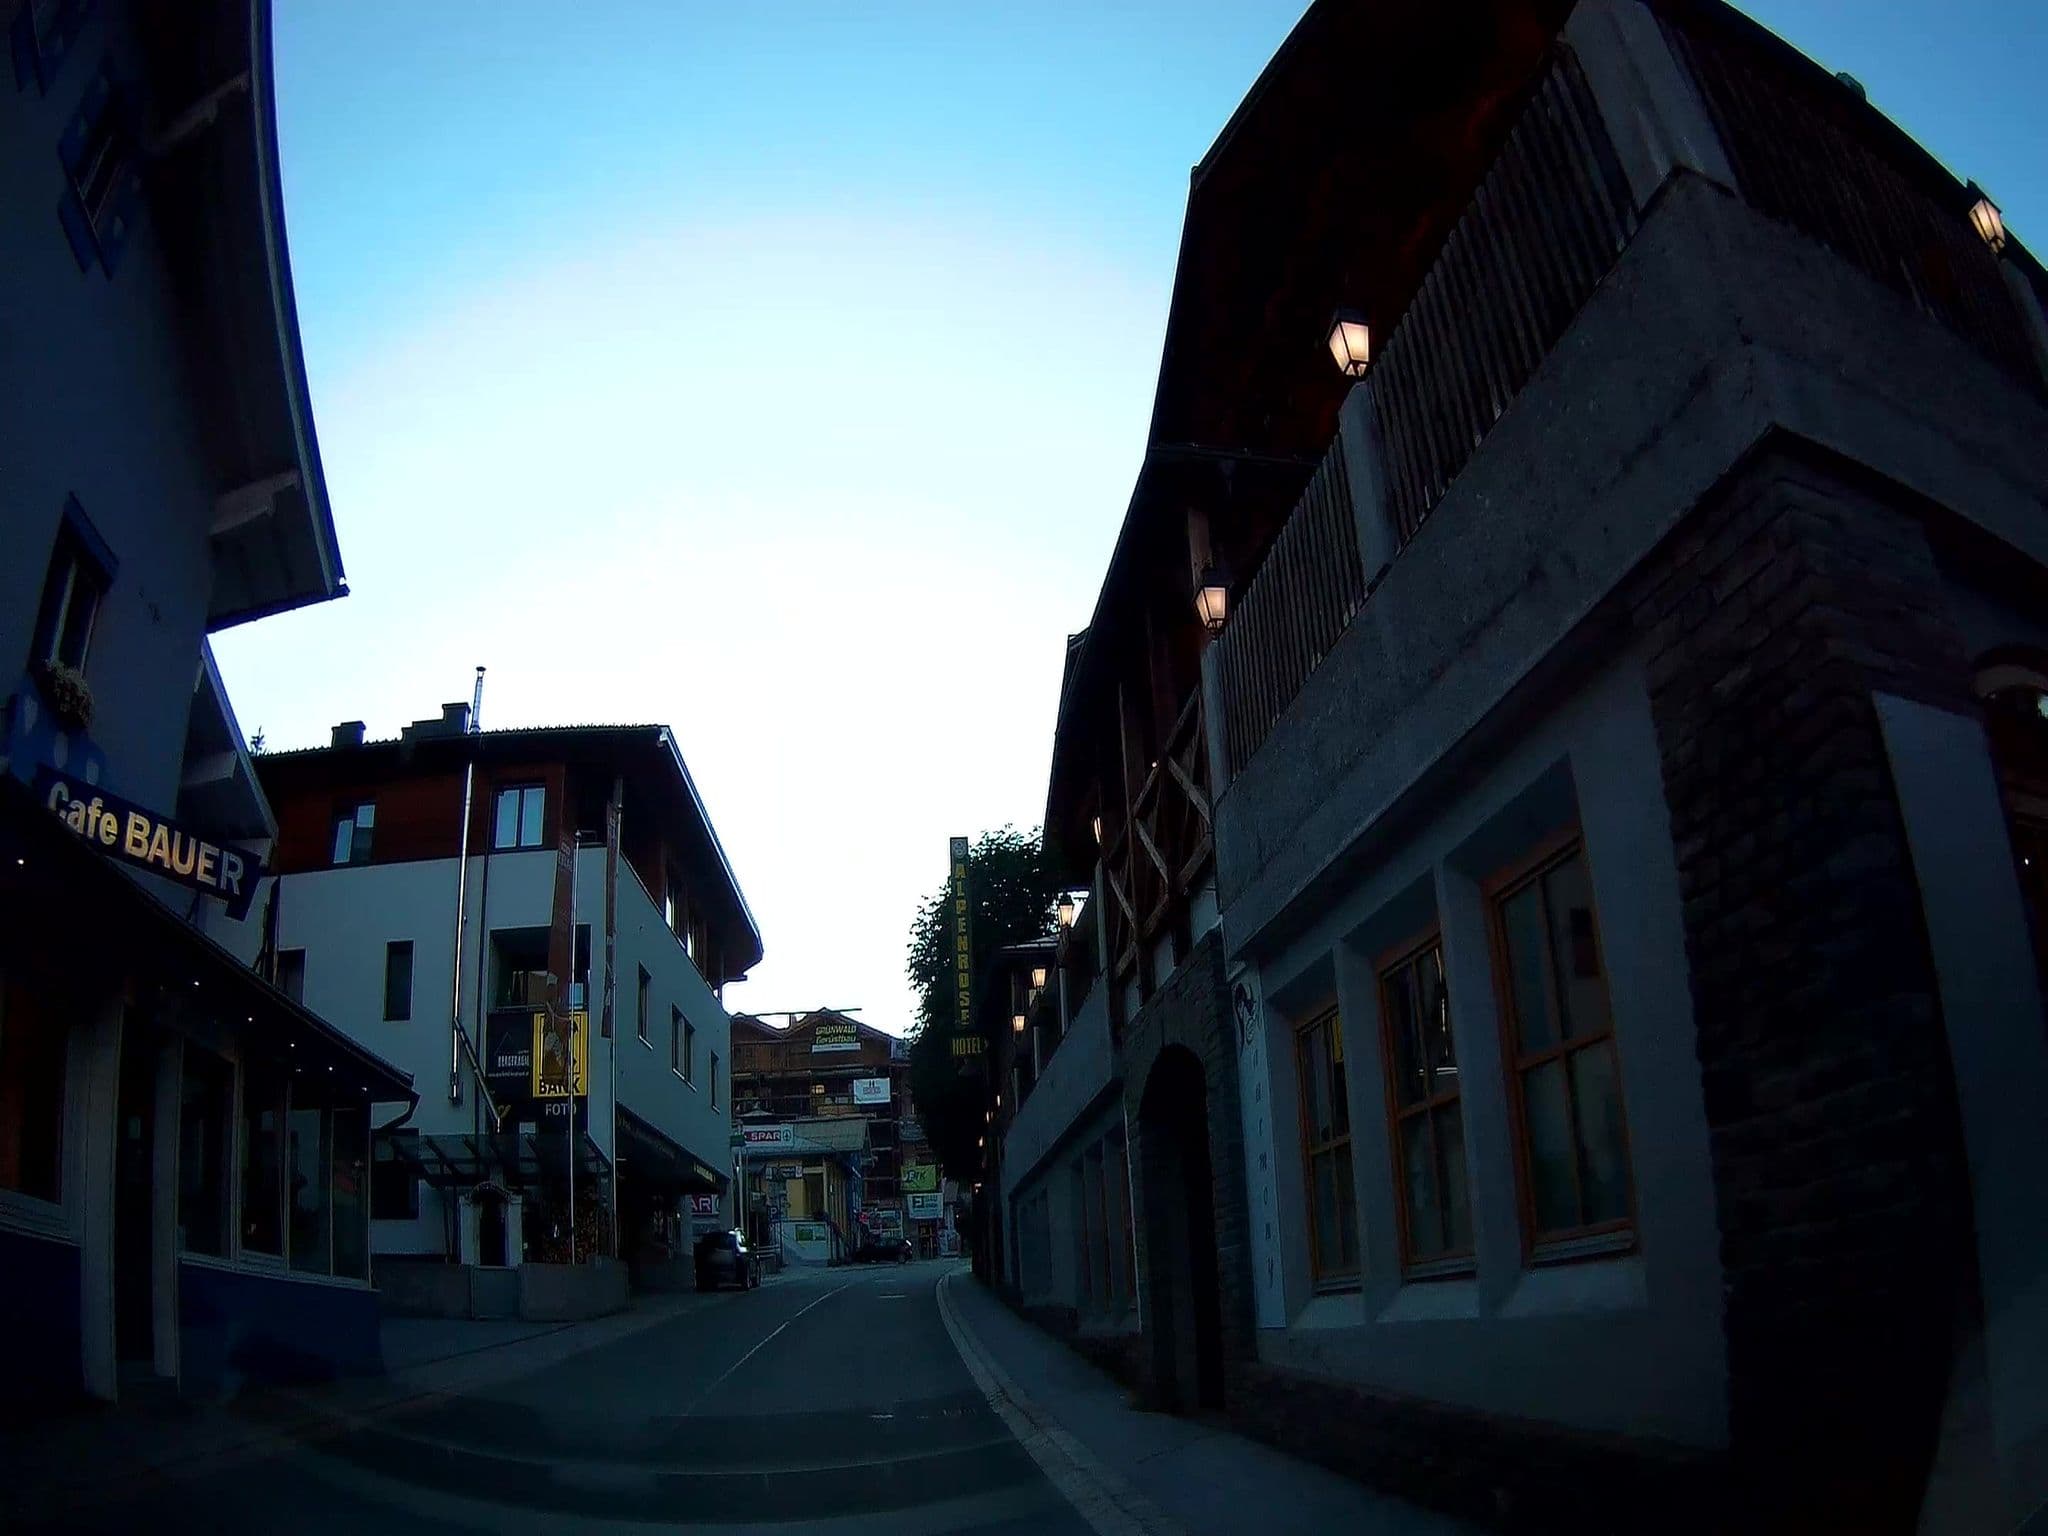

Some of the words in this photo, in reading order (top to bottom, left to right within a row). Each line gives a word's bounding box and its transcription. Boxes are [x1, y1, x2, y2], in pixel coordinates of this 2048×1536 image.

[125, 811, 244, 896] BAUER
[956, 864, 971, 1024] ALPENROSE
[952, 1036, 982, 1056] HOTEL
[539, 1077, 580, 1094] BANK
[751, 1131, 781, 1141] SPAR
